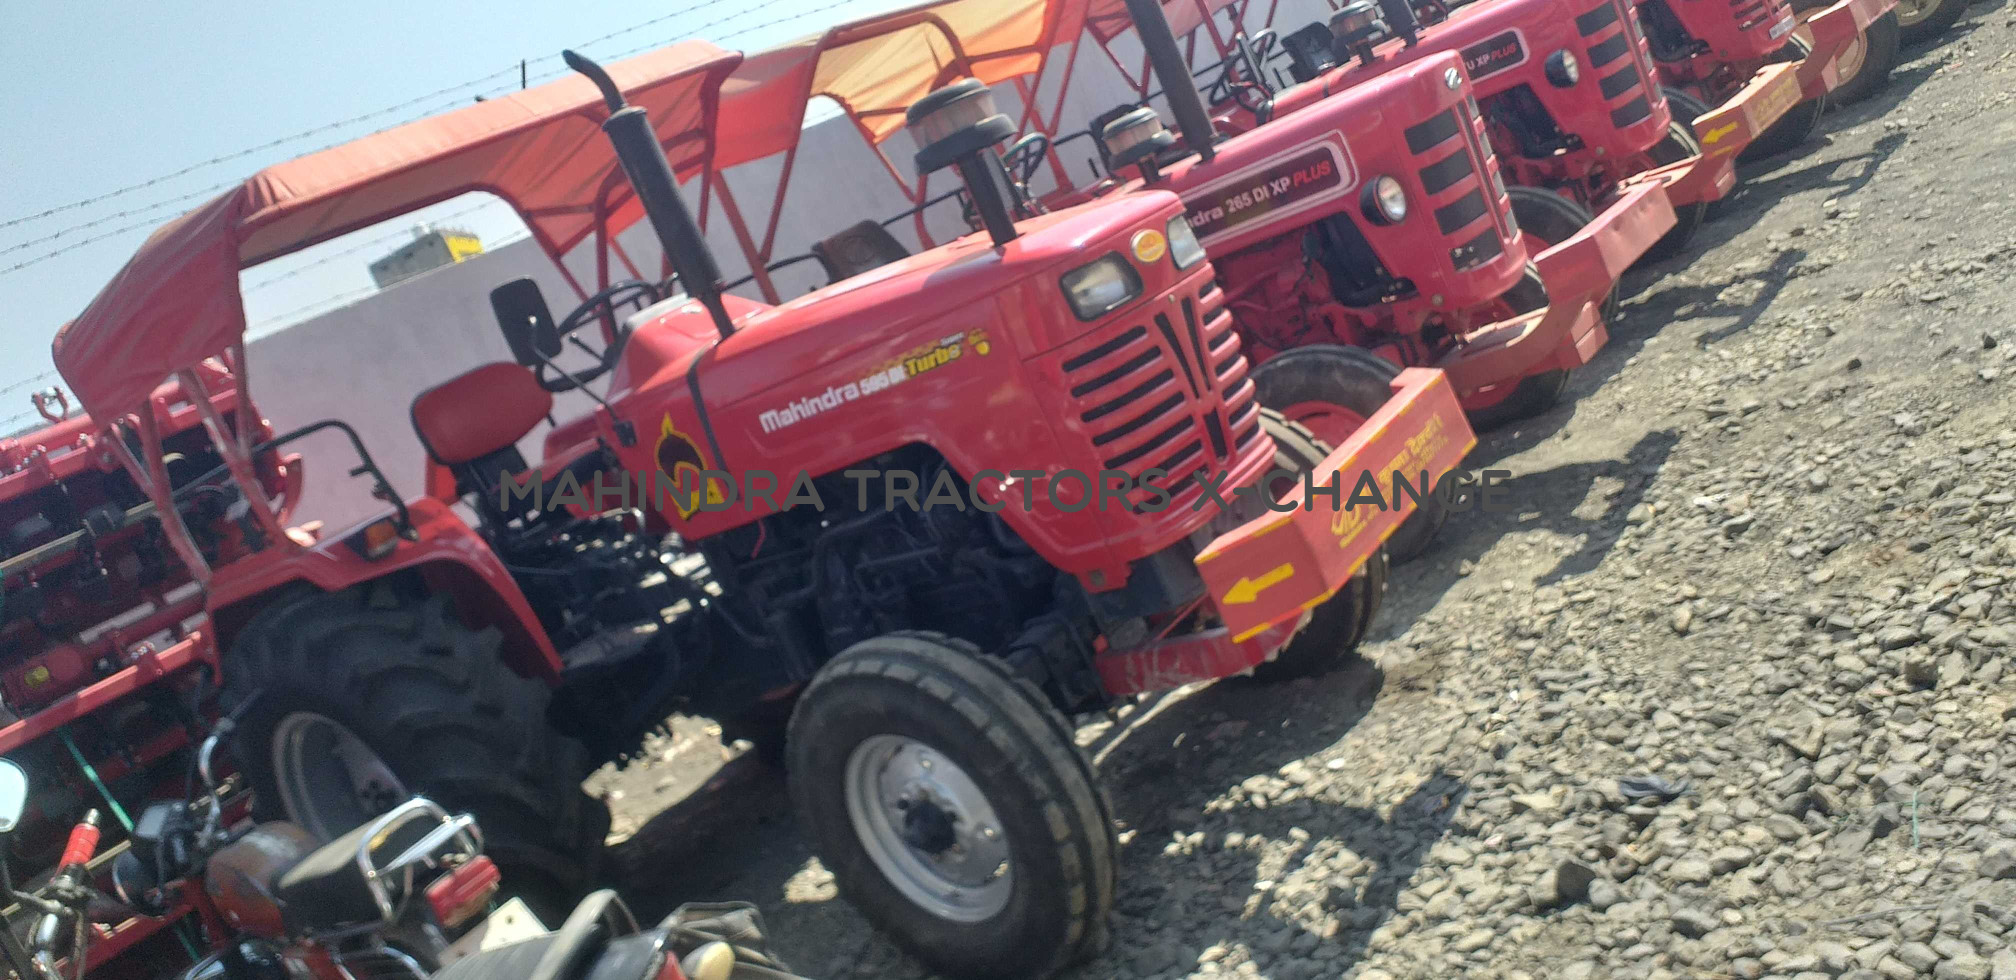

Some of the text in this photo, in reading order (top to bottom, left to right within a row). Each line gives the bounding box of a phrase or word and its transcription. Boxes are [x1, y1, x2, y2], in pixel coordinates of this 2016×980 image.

[1225, 192, 1253, 213] 265
[1252, 186, 1270, 203] DI
[1269, 176, 1291, 196] XP
[1293, 160, 1332, 187] PLUS
[758, 381, 861, 434] Mahindra
